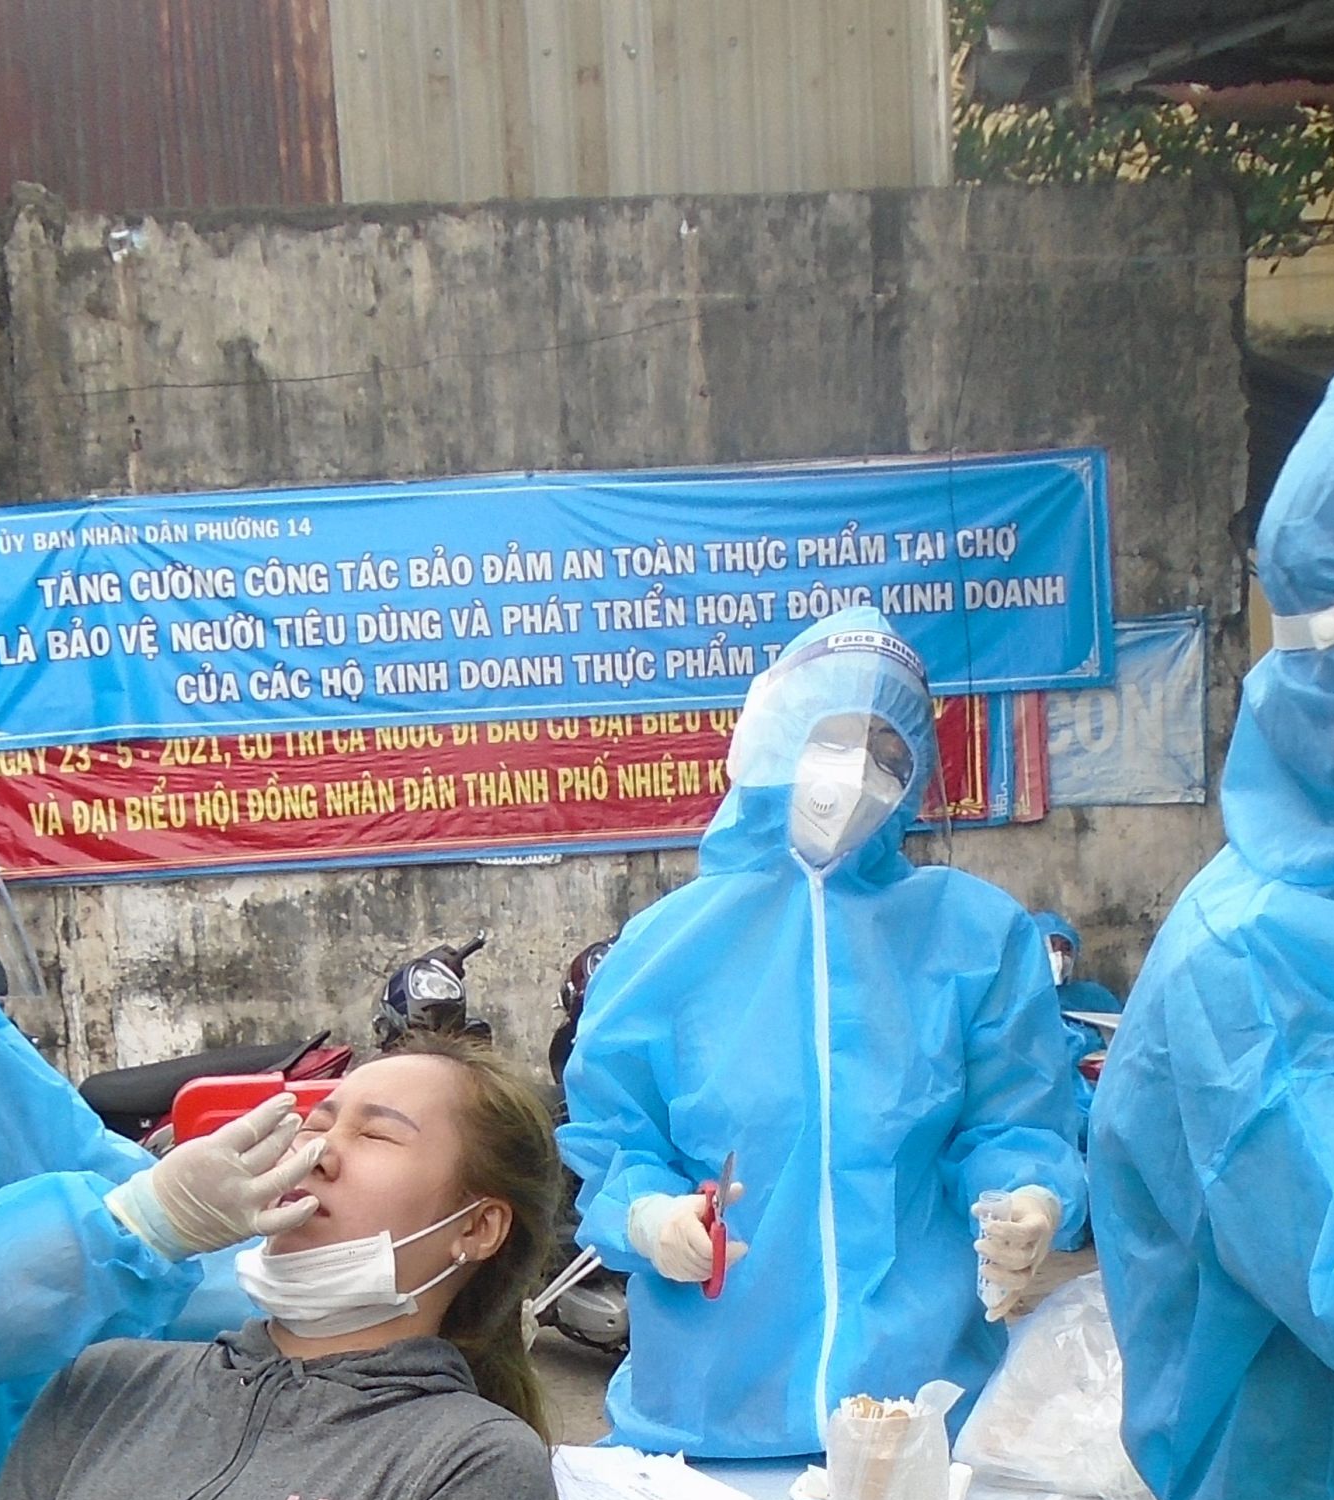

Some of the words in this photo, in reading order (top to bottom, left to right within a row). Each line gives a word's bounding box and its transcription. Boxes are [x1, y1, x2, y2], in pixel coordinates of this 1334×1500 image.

[33, 530, 75, 552] BAN
[82, 522, 138, 546] NHÂN
[144, 519, 188, 544] DÂN
[195, 515, 279, 542] PHƯỜNG
[286, 517, 313, 538] 14
[37, 570, 122, 609] TĂNG
[129, 561, 236, 602] CƯỜNG
[243, 557, 329, 598] CÔNG
[335, 552, 399, 592] TÁC
[408, 545, 474, 588] BẢO
[481, 541, 553, 585] ĐẢM
[562, 550, 604, 581] AN
[611, 538, 696, 578] TOÀN
[703, 535, 787, 577] THỰC
[797, 520, 886, 568] PHẨM
[894, 531, 946, 567] TẠI
[955, 522, 1017, 563] CHỢ
[46, 615, 111, 661] BẢO
[118, 615, 159, 660] VỆ
[170, 611, 265, 653] NGƯỜI
[273, 608, 346, 648] TIÊU
[356, 604, 443, 644] DÙNG
[450, 599, 492, 638] VÀ
[501, 595, 582, 636] PHÁT
[592, 582, 686, 631] TRIỂN
[695, 591, 776, 629] HOẠT
[882, 581, 954, 615] KINH
[964, 575, 1065, 611] DOANH
[834, 635, 875, 645] Face
[176, 662, 241, 705] CỦA
[249, 661, 311, 700] CÁC
[321, 659, 364, 702] HỘ
[374, 660, 449, 695] KINH
[459, 656, 563, 691] DOANH
[571, 645, 656, 688] THỰC
[666, 631, 754, 679] PHẨM
[58, 744, 92, 773] 23
[117, 743, 134, 769] 5
[285, 729, 324, 757] TRI
[28, 793, 65, 836] VÀ
[72, 797, 117, 840] ĐẠI
[124, 775, 187, 831] BIỂU
[194, 781, 239, 832] HỘI
[246, 771, 318, 822] ĐỒNG
[324, 770, 396, 817] NHÂN
[403, 766, 456, 812] DÂN
[462, 761, 549, 807] THÀNH
[558, 751, 610, 802] PHỐ
[618, 752, 701, 804] NHIỆM
